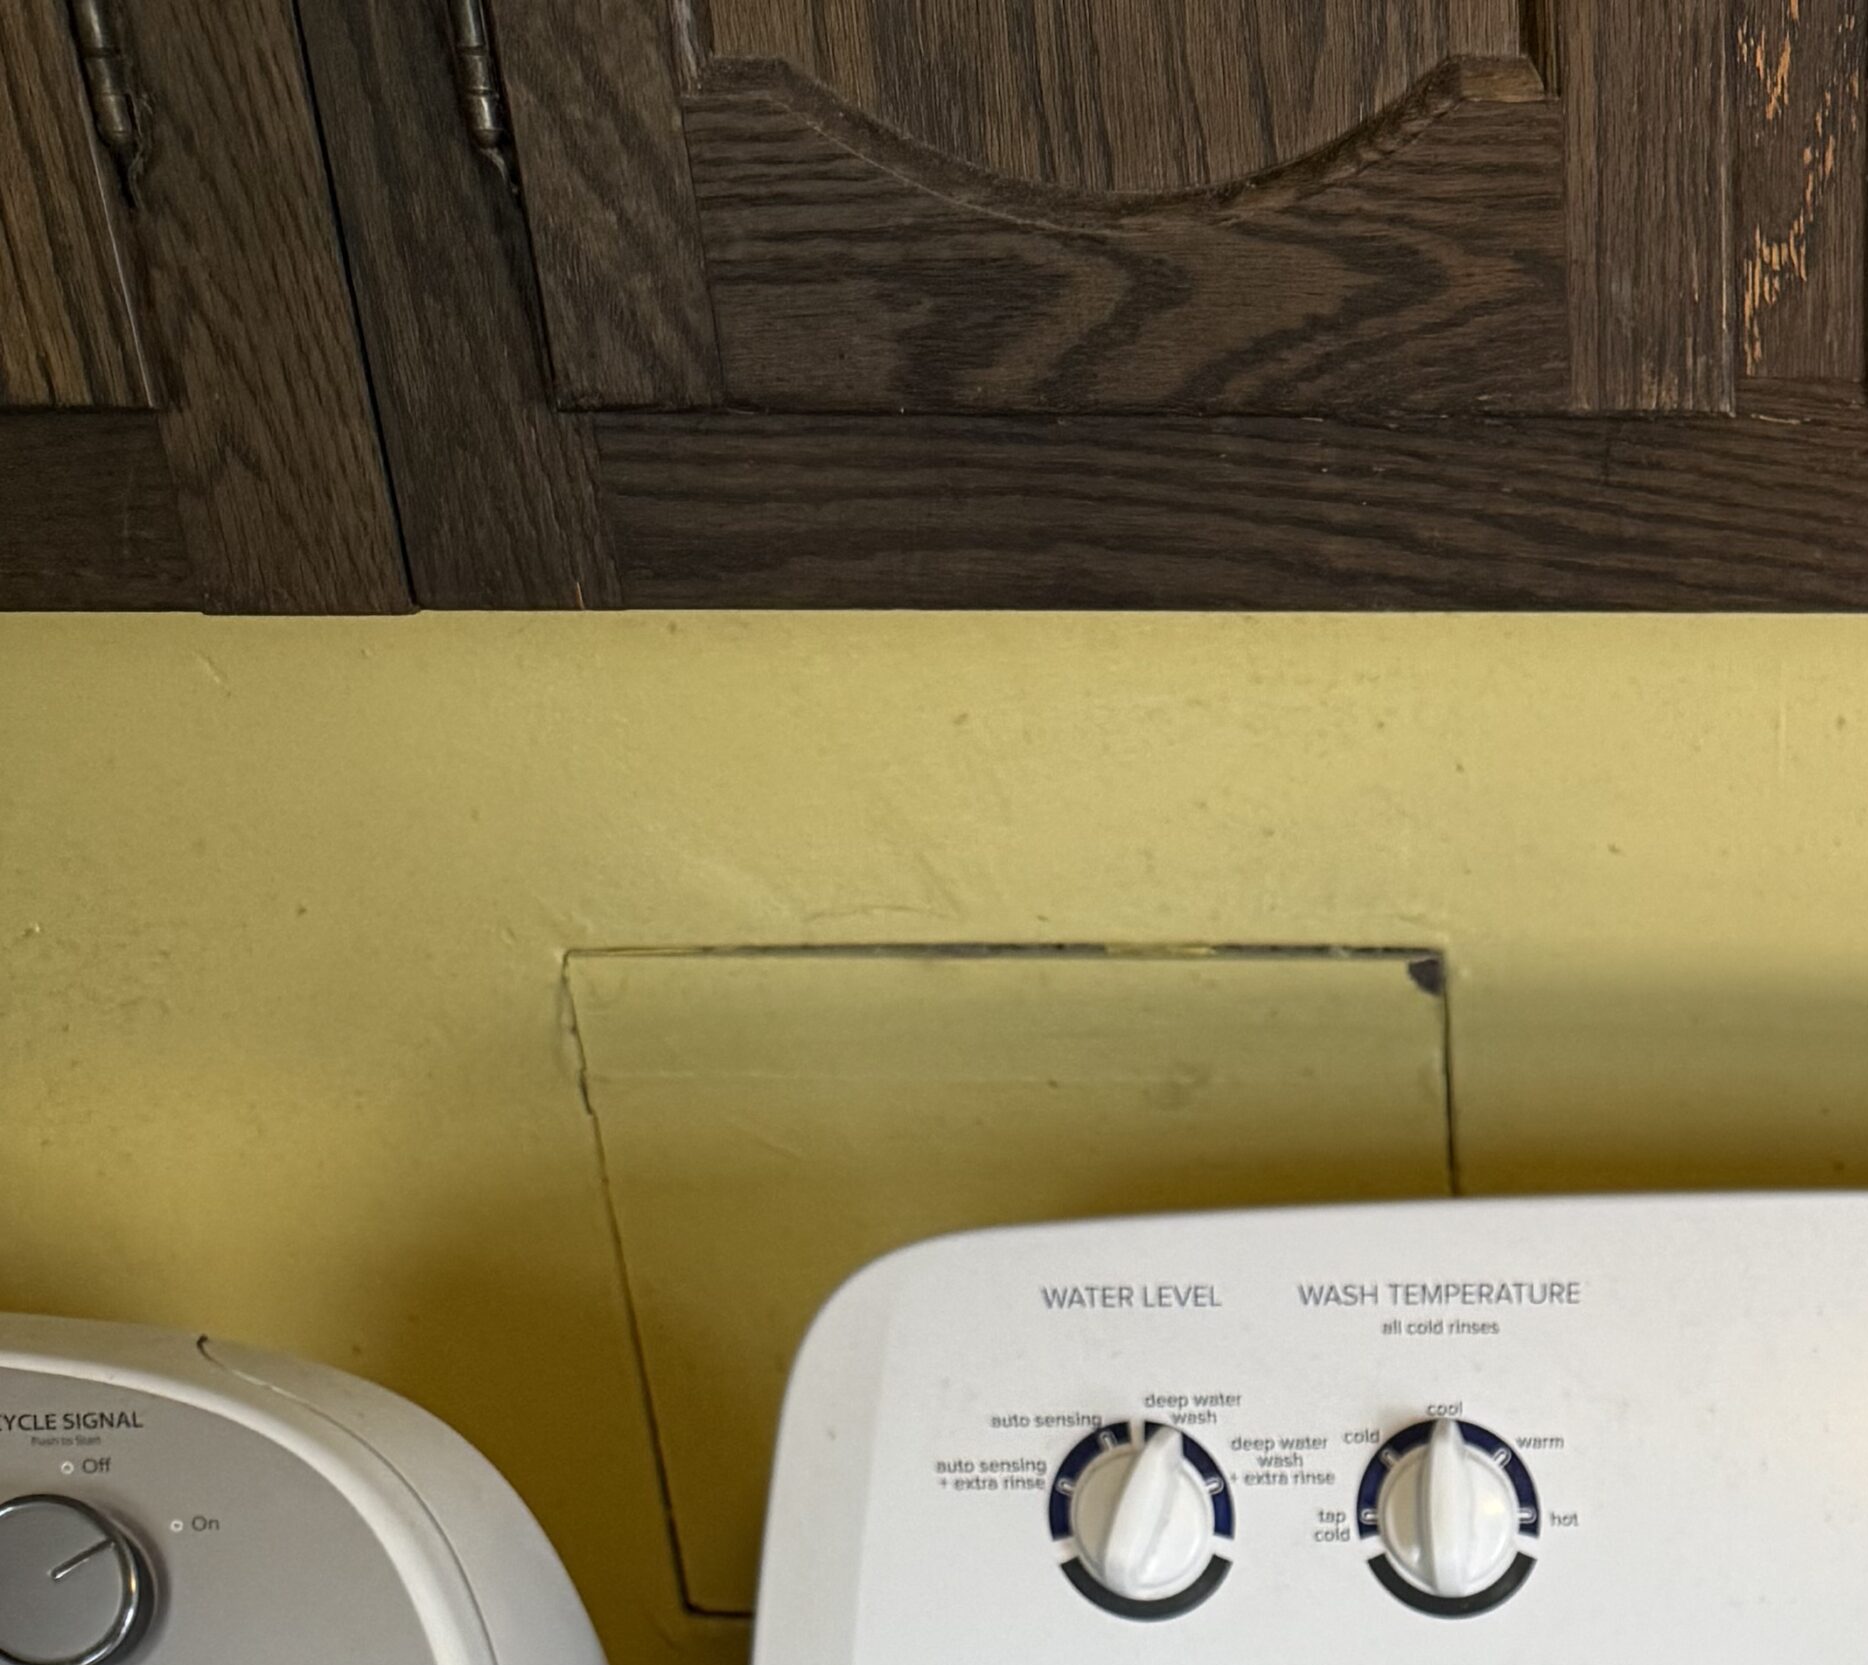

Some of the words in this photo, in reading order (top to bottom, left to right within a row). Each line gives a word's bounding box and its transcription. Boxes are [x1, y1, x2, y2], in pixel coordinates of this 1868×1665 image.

[1042, 1286, 1133, 1309] WATER
[1142, 1285, 1222, 1308] LEVEL
[1298, 1284, 1378, 1307] WASH
[1388, 1282, 1582, 1306] TEMPERATURE
[1381, 1320, 1401, 1335] all
[1406, 1320, 1443, 1335] cold
[1449, 1320, 1500, 1335] rinses
[1143, 1393, 1189, 1410] deep
[1192, 1393, 1242, 1408] water
[1427, 1401, 1463, 1417] cool
[63, 1411, 144, 1431] SIGNAL
[990, 1413, 1030, 1428] auto
[1035, 1411, 1103, 1430] sensing
[1171, 1409, 1217, 1425] wash
[1231, 1437, 1275, 1453] deep
[1278, 1437, 1328, 1450] water
[1344, 1429, 1380, 1445] cold
[1516, 1436, 1565, 1449] warm
[82, 1457, 111, 1474] Off
[936, 1459, 975, 1474] auto
[979, 1457, 1047, 1475] sensing
[1257, 1453, 1303, 1468] wash
[954, 1477, 998, 1491] extra
[1003, 1476, 1046, 1490] rinse
[1244, 1472, 1289, 1486] extra
[1293, 1471, 1335, 1486] rinse
[192, 1516, 220, 1531] On
[1318, 1509, 1346, 1526] tap
[1550, 1512, 1579, 1527] hot
[1314, 1527, 1351, 1542] cold
